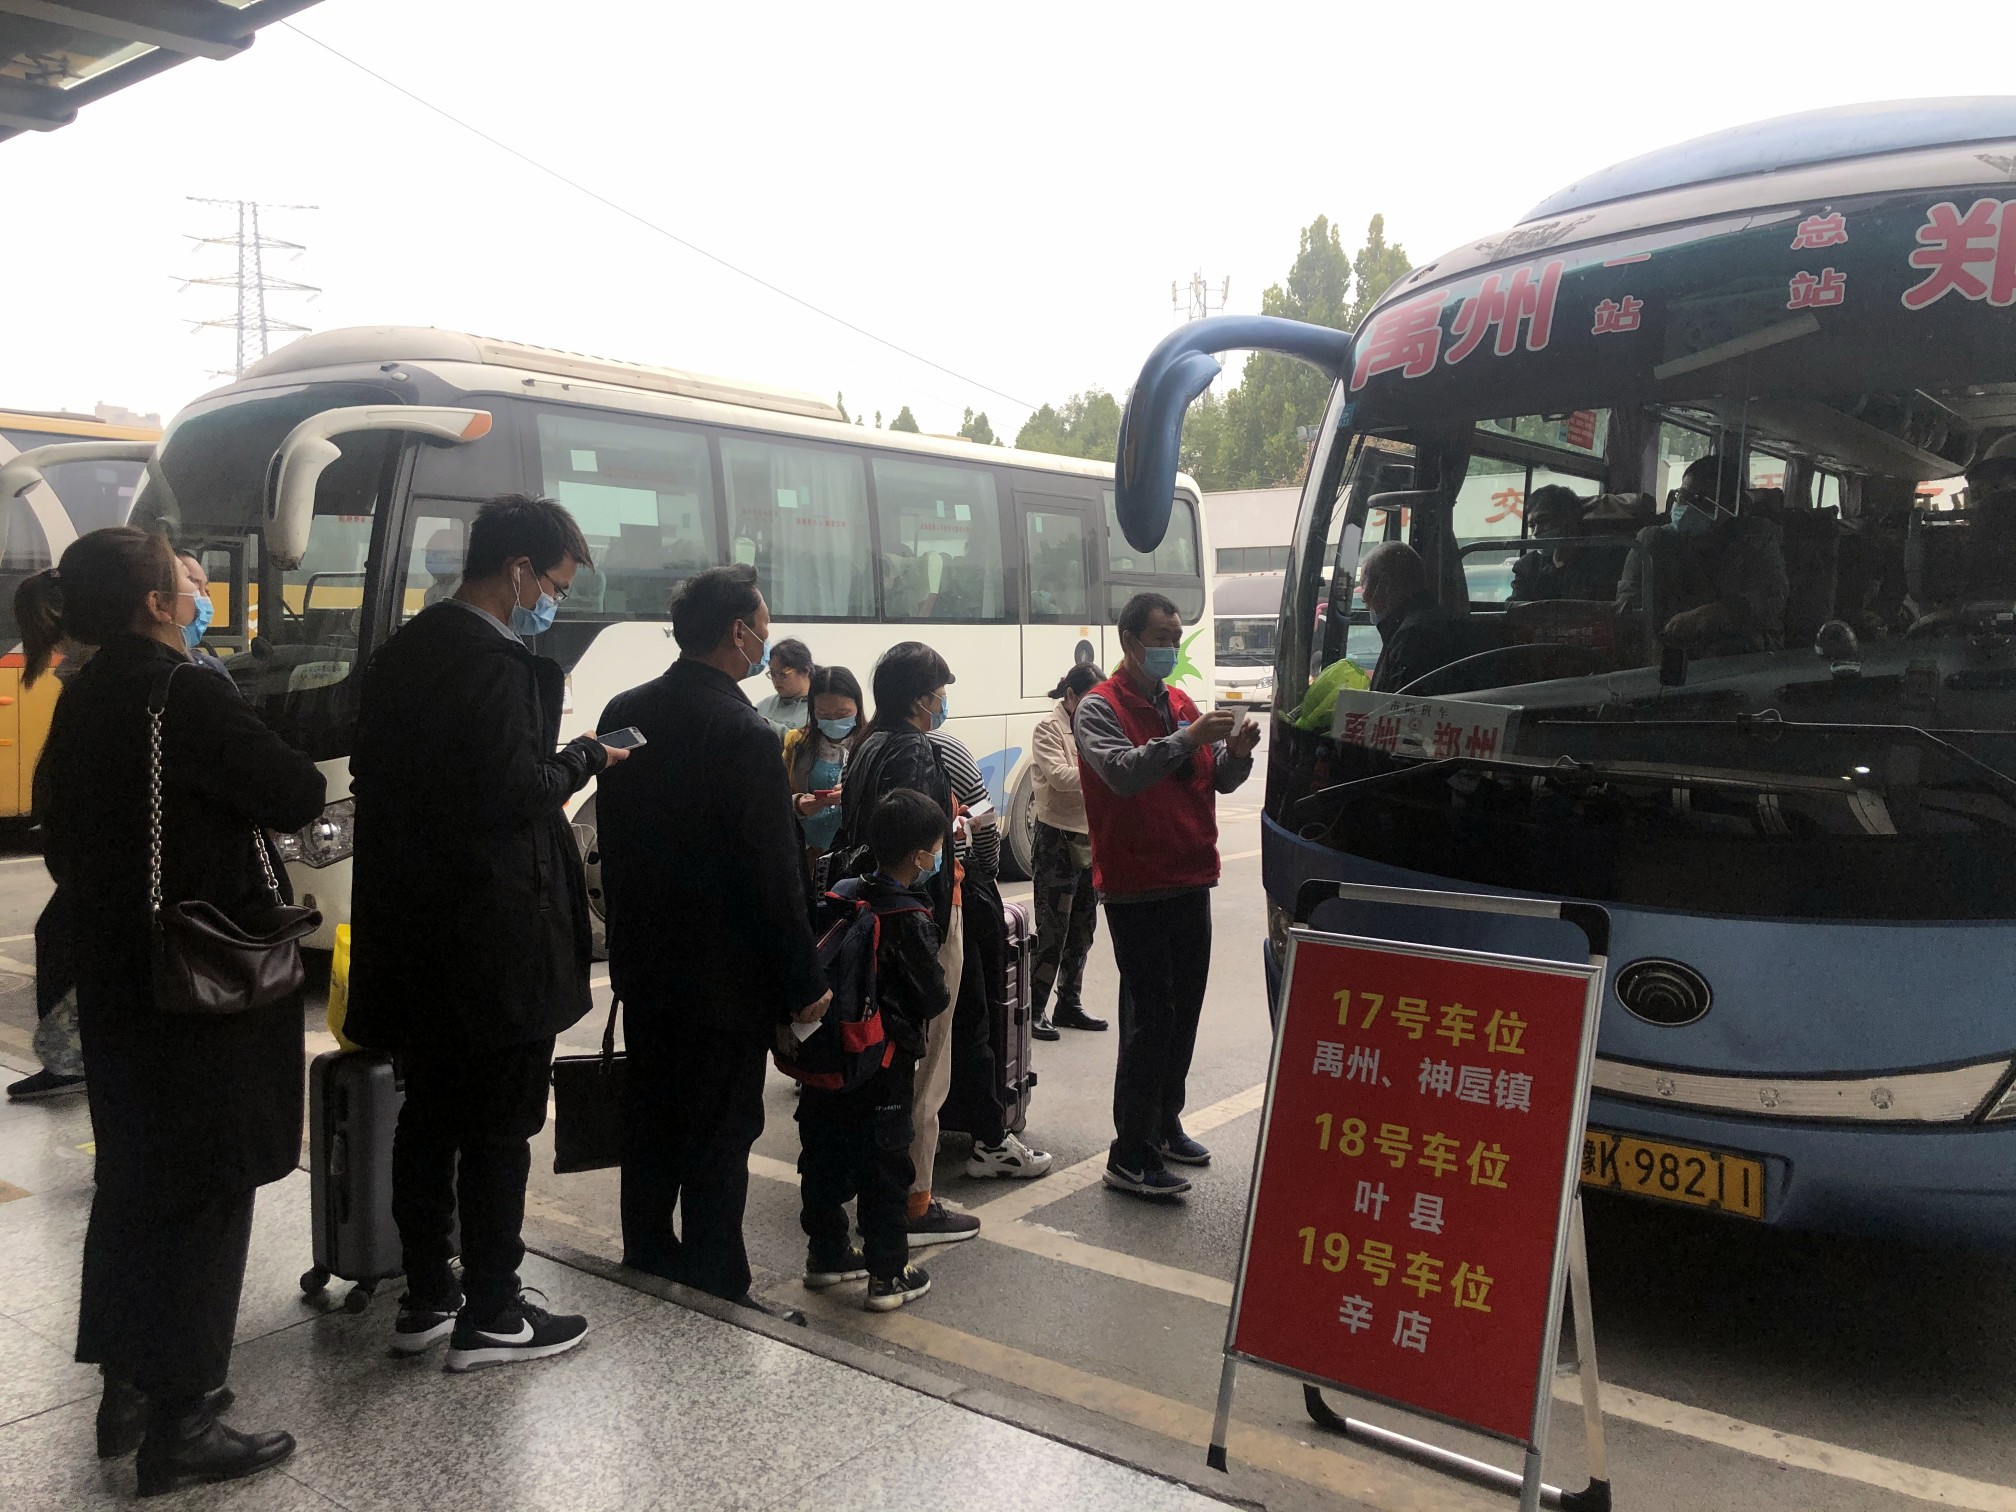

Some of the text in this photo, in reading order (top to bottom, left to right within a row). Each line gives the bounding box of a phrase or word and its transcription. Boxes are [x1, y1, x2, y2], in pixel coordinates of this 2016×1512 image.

[1787, 212, 1848, 309] 总站
[1350, 259, 1565, 392] 禹州
[1332, 989, 1529, 1056] 17号车位
[1314, 1112, 1511, 1189] 18号车位
[1298, 1226, 1495, 1313] 19号车位
